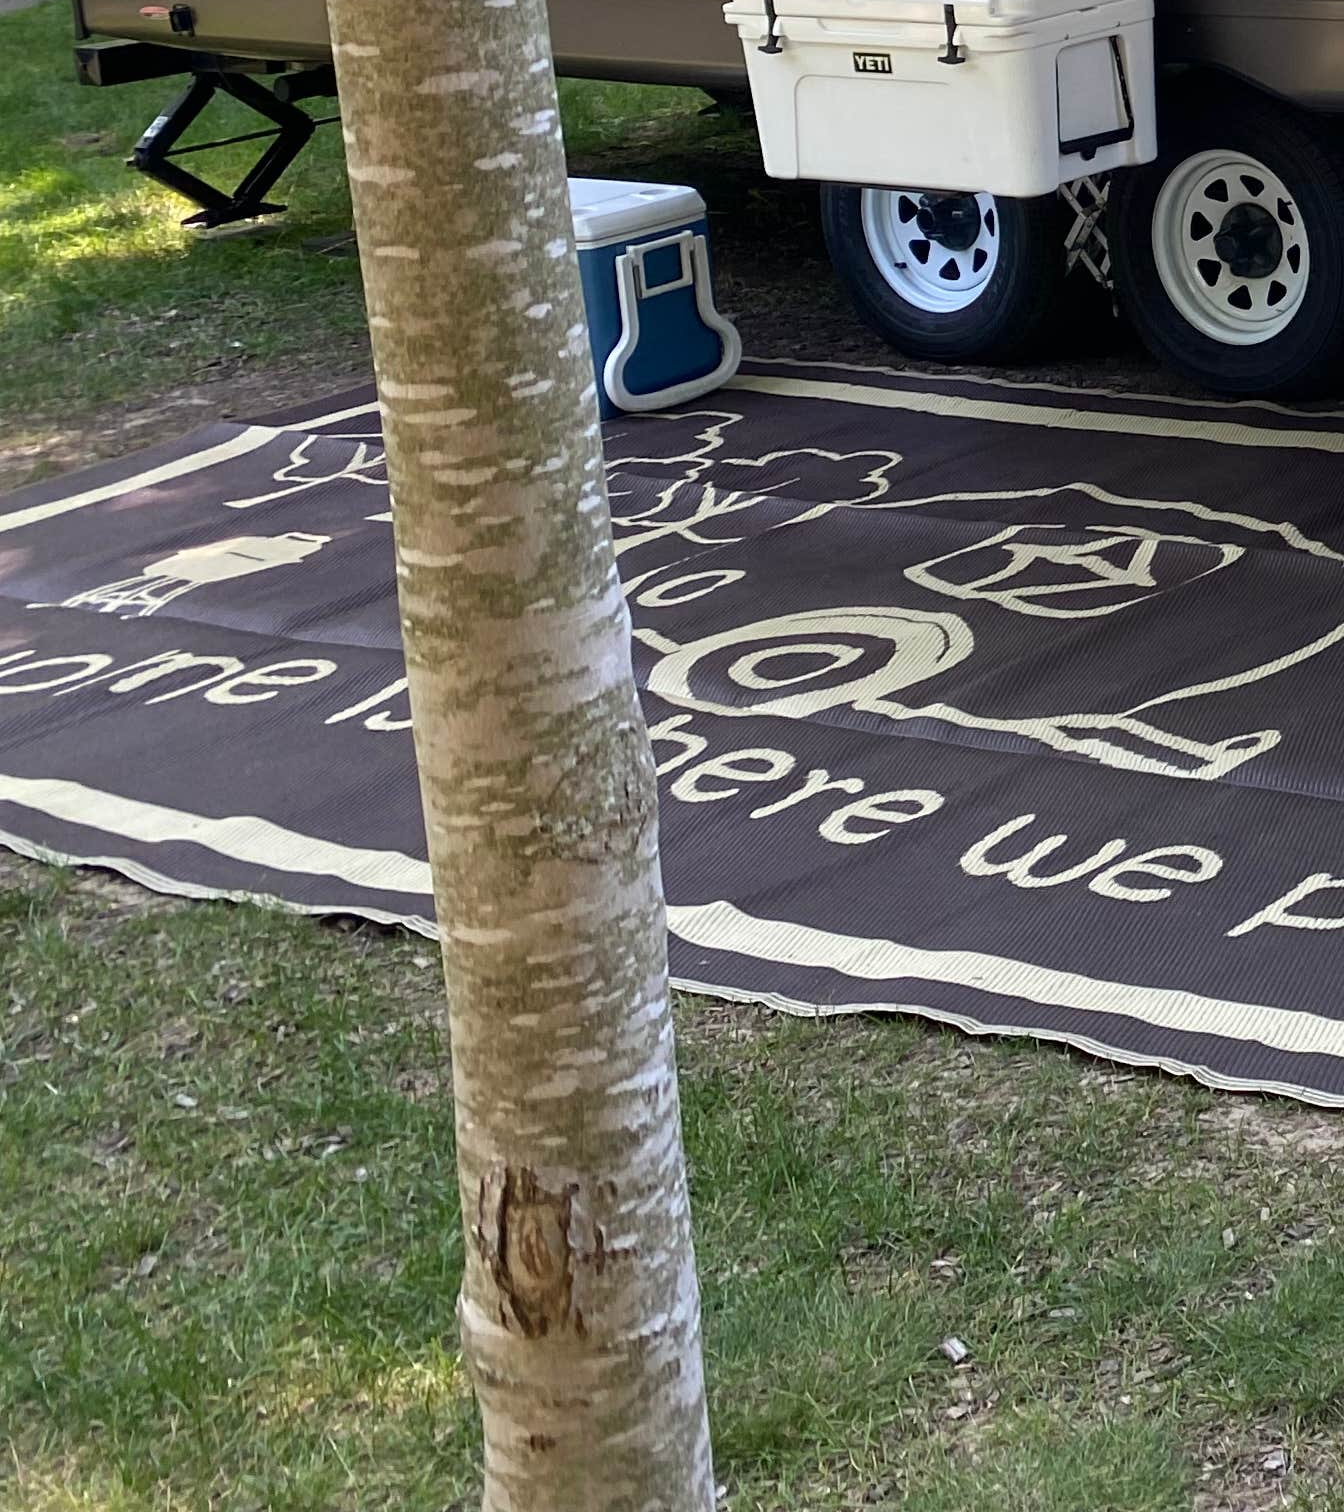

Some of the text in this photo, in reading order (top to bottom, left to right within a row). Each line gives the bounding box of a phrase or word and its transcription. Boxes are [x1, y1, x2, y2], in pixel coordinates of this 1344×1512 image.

[854, 55, 890, 71] YETI
[0, 649, 338, 705] ome
[647, 714, 945, 845] here
[959, 813, 1222, 902] we
